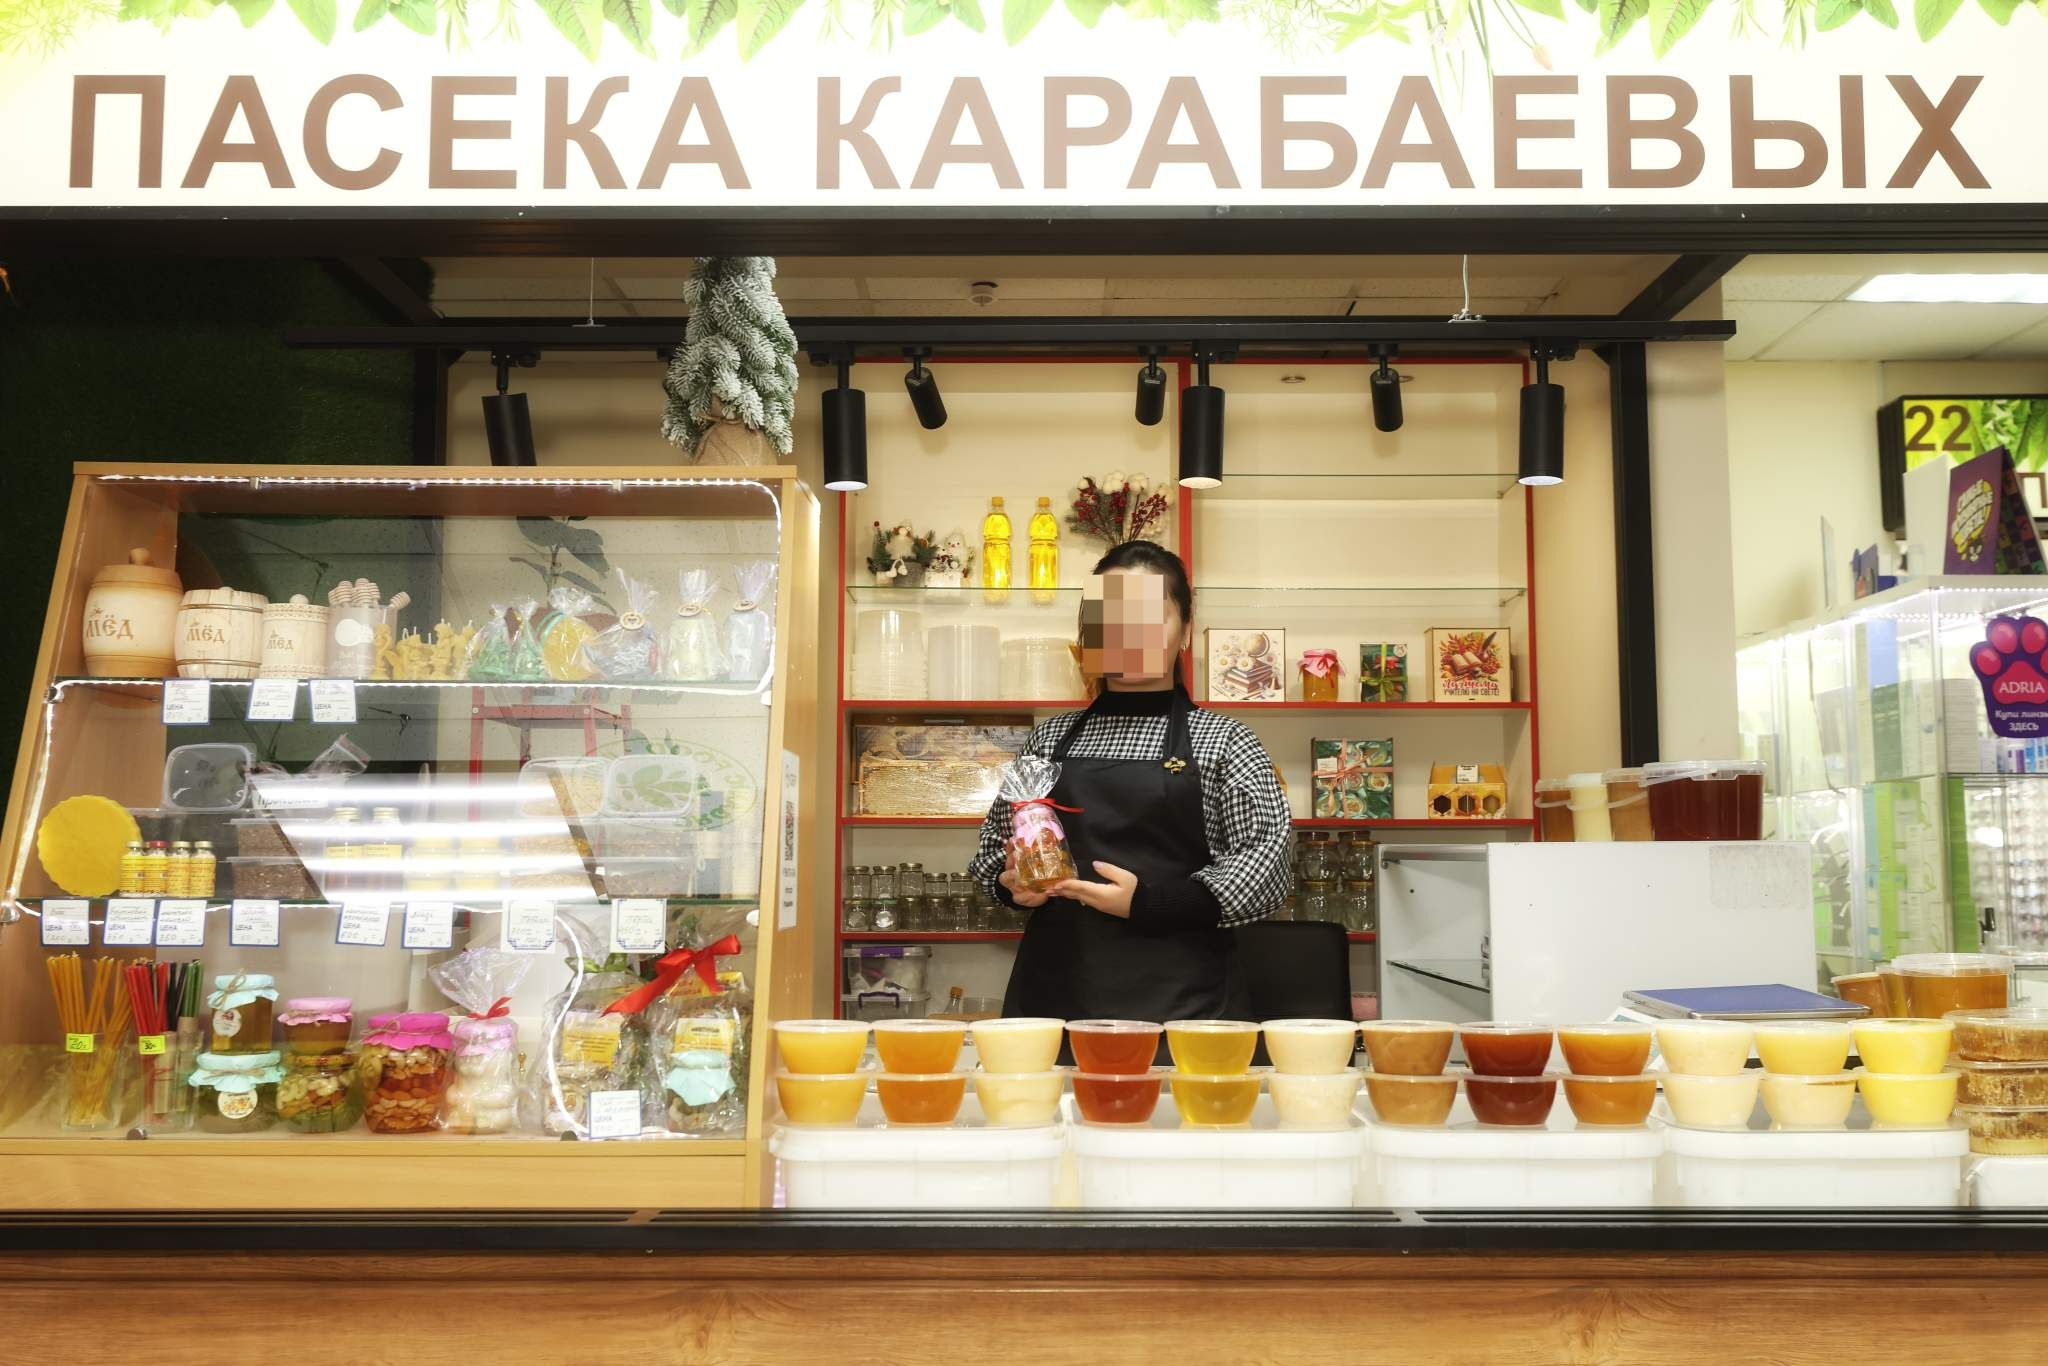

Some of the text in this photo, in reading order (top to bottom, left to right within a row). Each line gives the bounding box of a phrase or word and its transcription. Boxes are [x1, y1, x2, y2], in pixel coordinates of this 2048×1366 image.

[69, 73, 1993, 190] ПАСЕКА КАРАБАЕВЫХ
[1905, 405, 1973, 451] 22
[86, 614, 135, 640] МЁД
[186, 624, 226, 644] МЁД
[1999, 681, 2046, 694] ADRIA
[1995, 709, 2019, 720] Купи
[2008, 722, 2040, 732] ЗДЕСЬ
